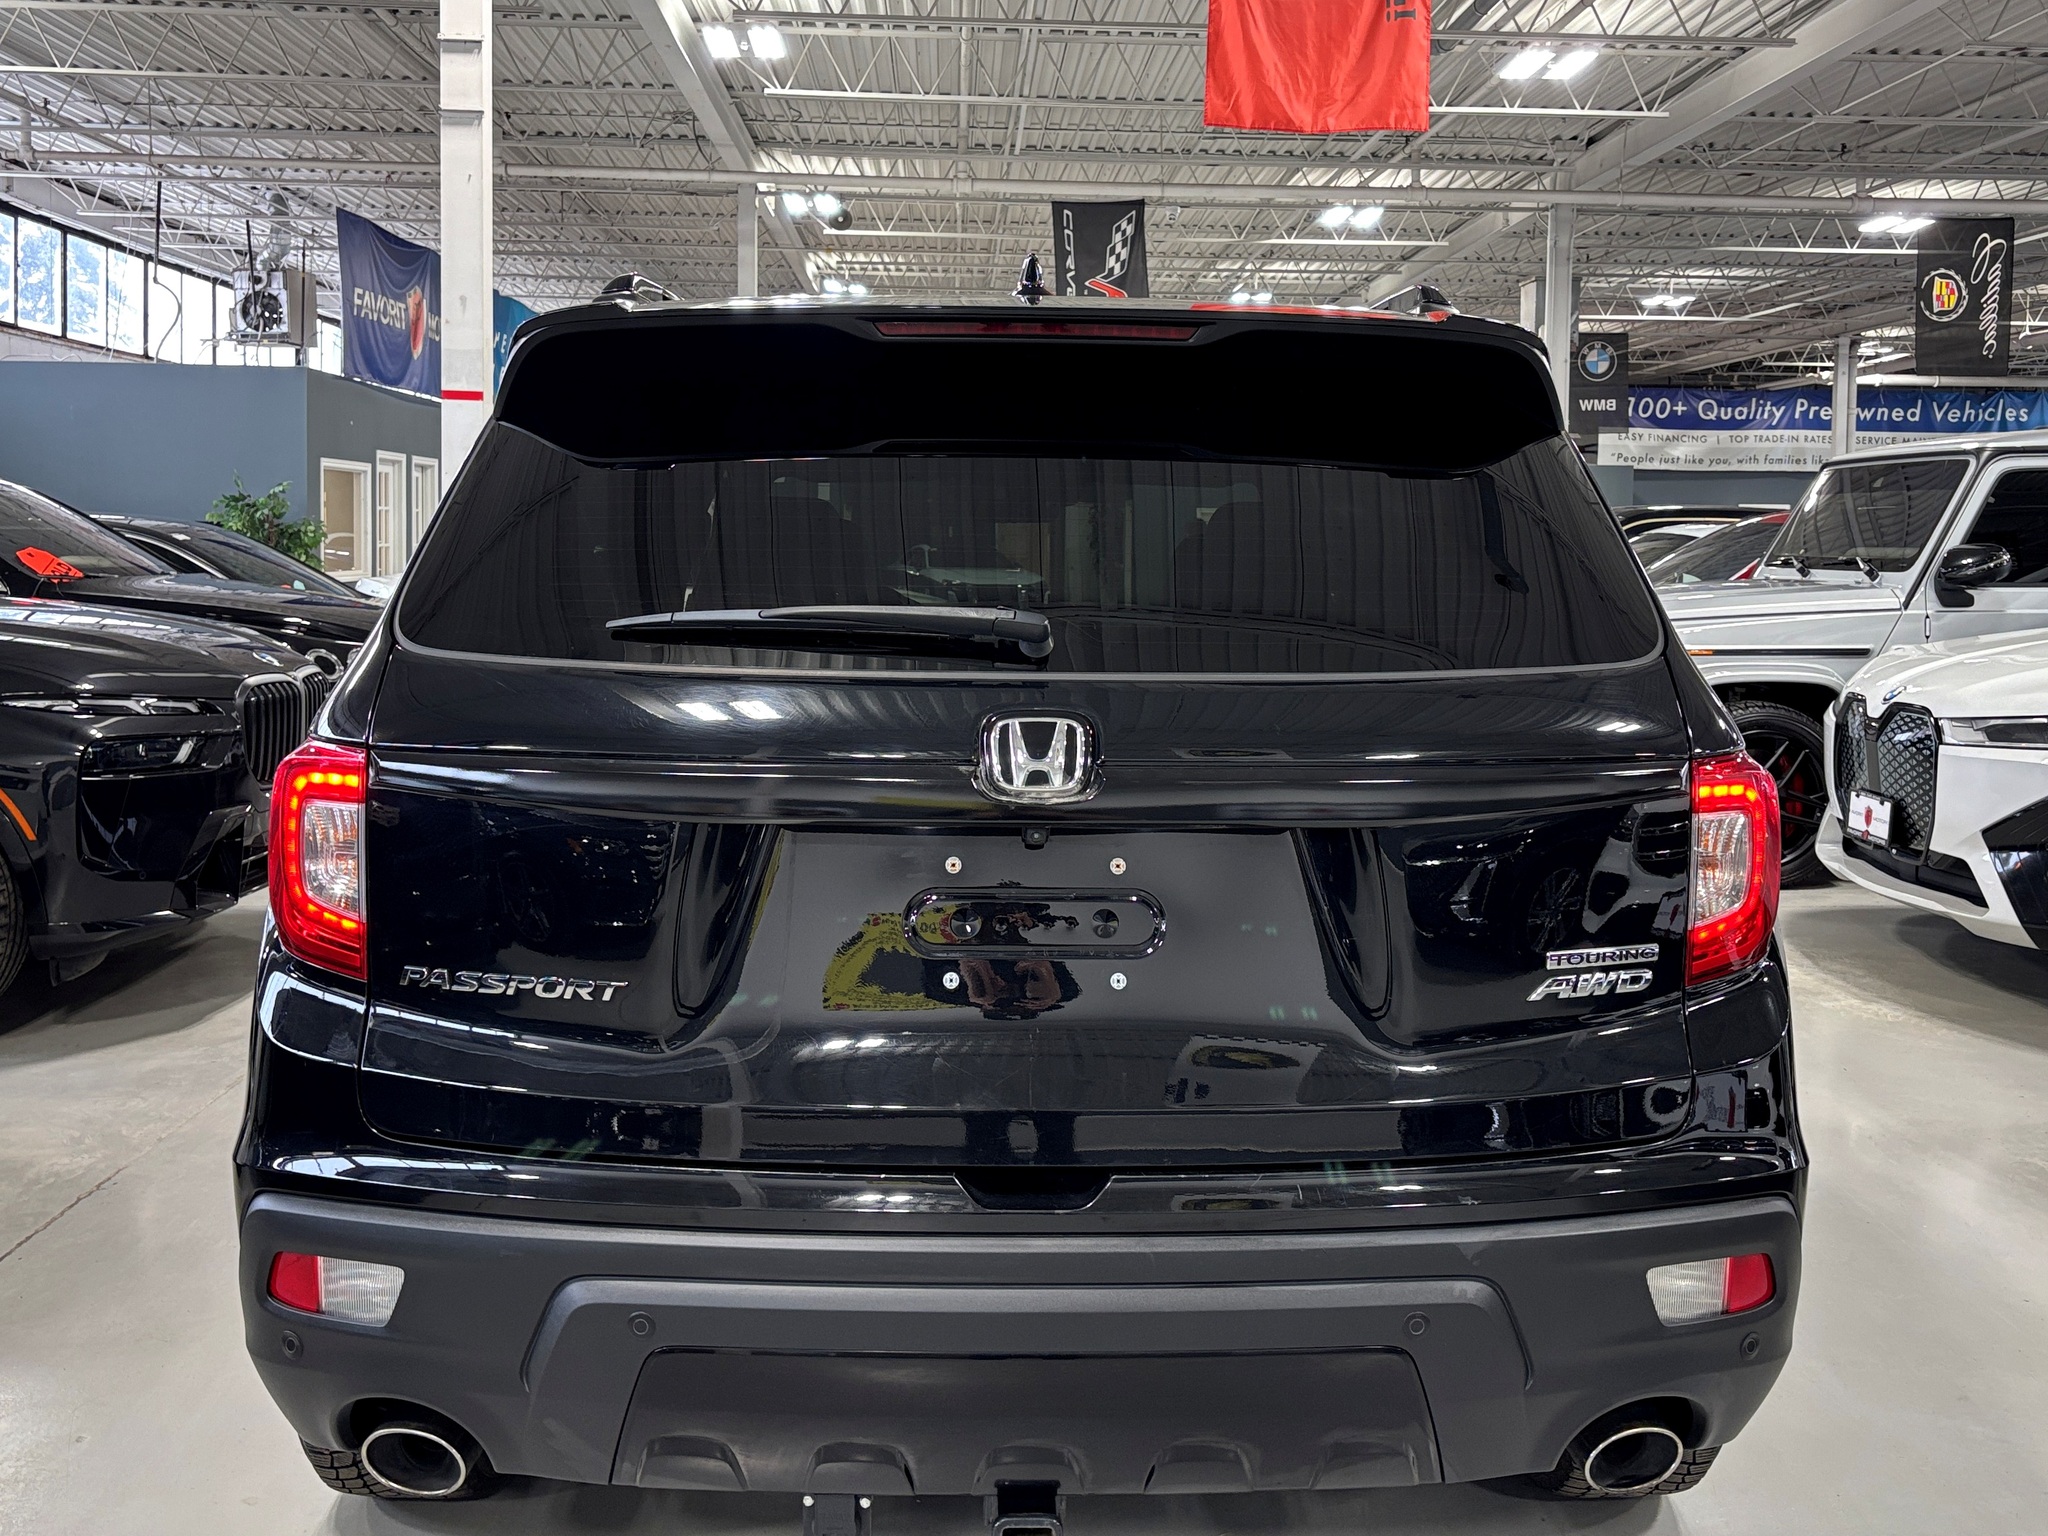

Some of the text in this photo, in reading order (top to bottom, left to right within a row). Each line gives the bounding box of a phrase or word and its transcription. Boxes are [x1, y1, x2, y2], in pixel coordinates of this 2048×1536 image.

[353, 287, 406, 330] FAVORIT
[1698, 397, 1785, 426] Quality
[1932, 399, 2029, 423] Vehicles
[1617, 433, 1644, 441] EASY
[1648, 433, 1708, 443] FINANCING
[1729, 434, 1749, 443] TOP
[1754, 434, 1799, 443] TRADE-IN
[1804, 434, 1832, 444] RATES
[1855, 436, 1897, 445] SERVICE
[1659, 454, 1680, 465] just
[1684, 454, 1704, 465] like
[1708, 457, 1731, 467] you,
[1736, 455, 1759, 465] with
[1763, 454, 1807, 465] families
[1549, 947, 1657, 966] TOURING
[400, 965, 628, 1001] PASSPORT
[1526, 968, 1653, 1002] AWD
